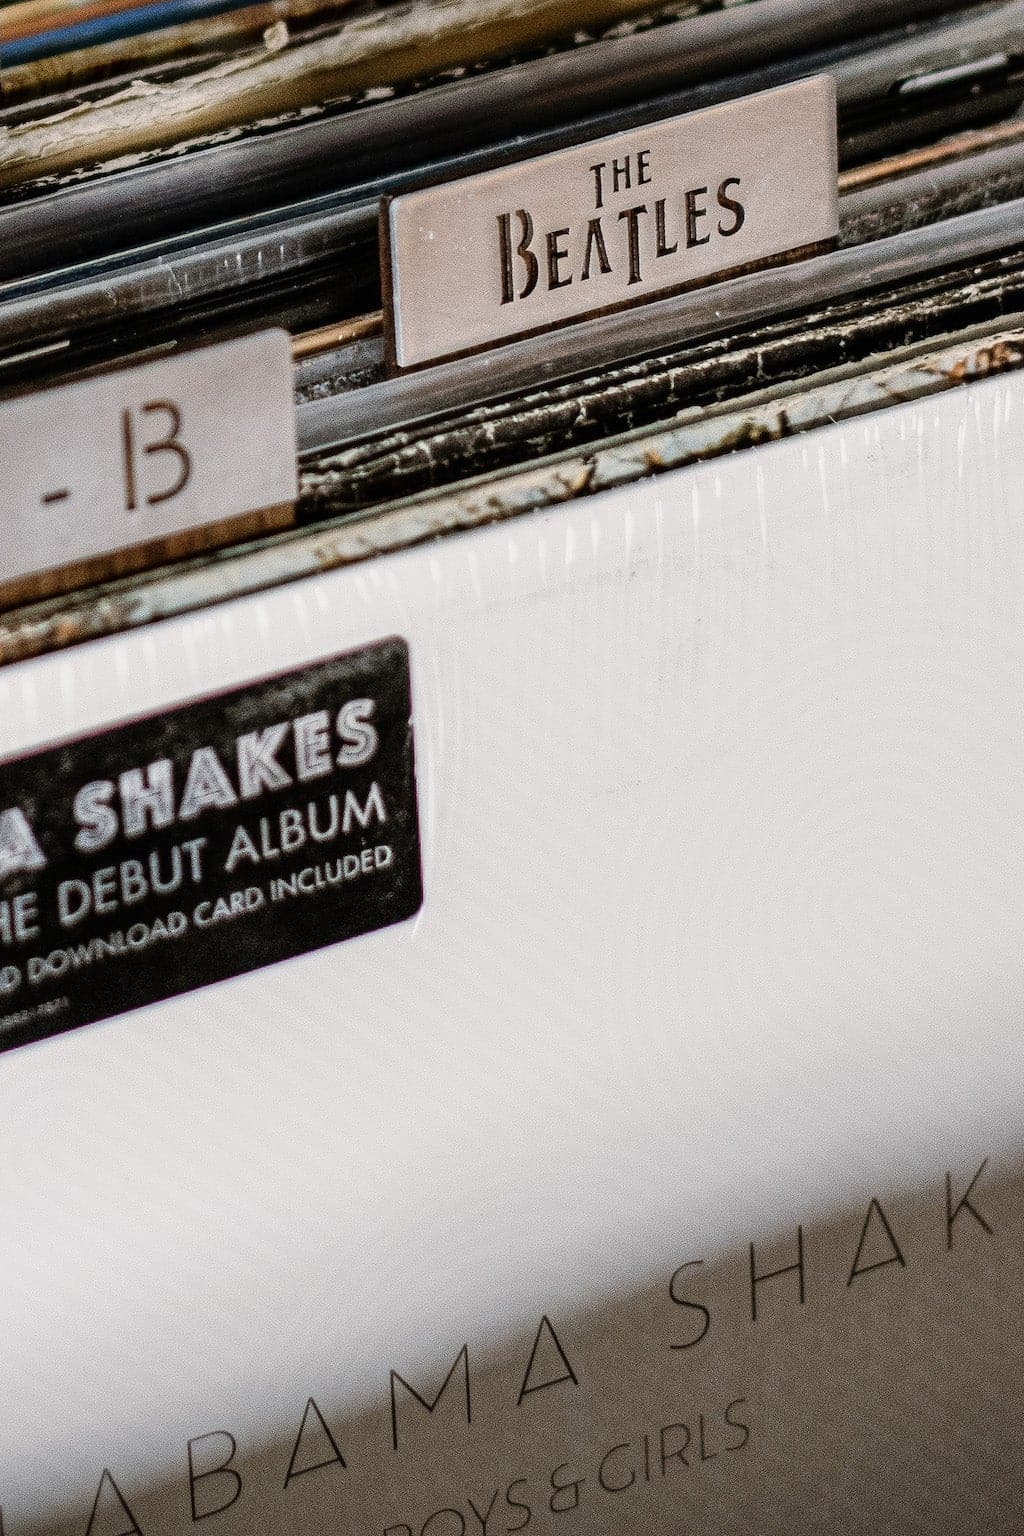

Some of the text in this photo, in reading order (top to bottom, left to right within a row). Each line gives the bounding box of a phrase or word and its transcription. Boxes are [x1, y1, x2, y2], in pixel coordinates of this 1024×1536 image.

[495, 176, 745, 306] BEATLES
[589, 149, 652, 209] THE
[120, 398, 192, 511] B
[72, 697, 380, 855] SHAKES
[27, 911, 189, 985] DOWNLOAD
[192, 886, 265, 929] CARD
[269, 844, 394, 903] INCLUDED
[57, 836, 209, 929] DEBUT
[223, 780, 388, 874] ALBUM
